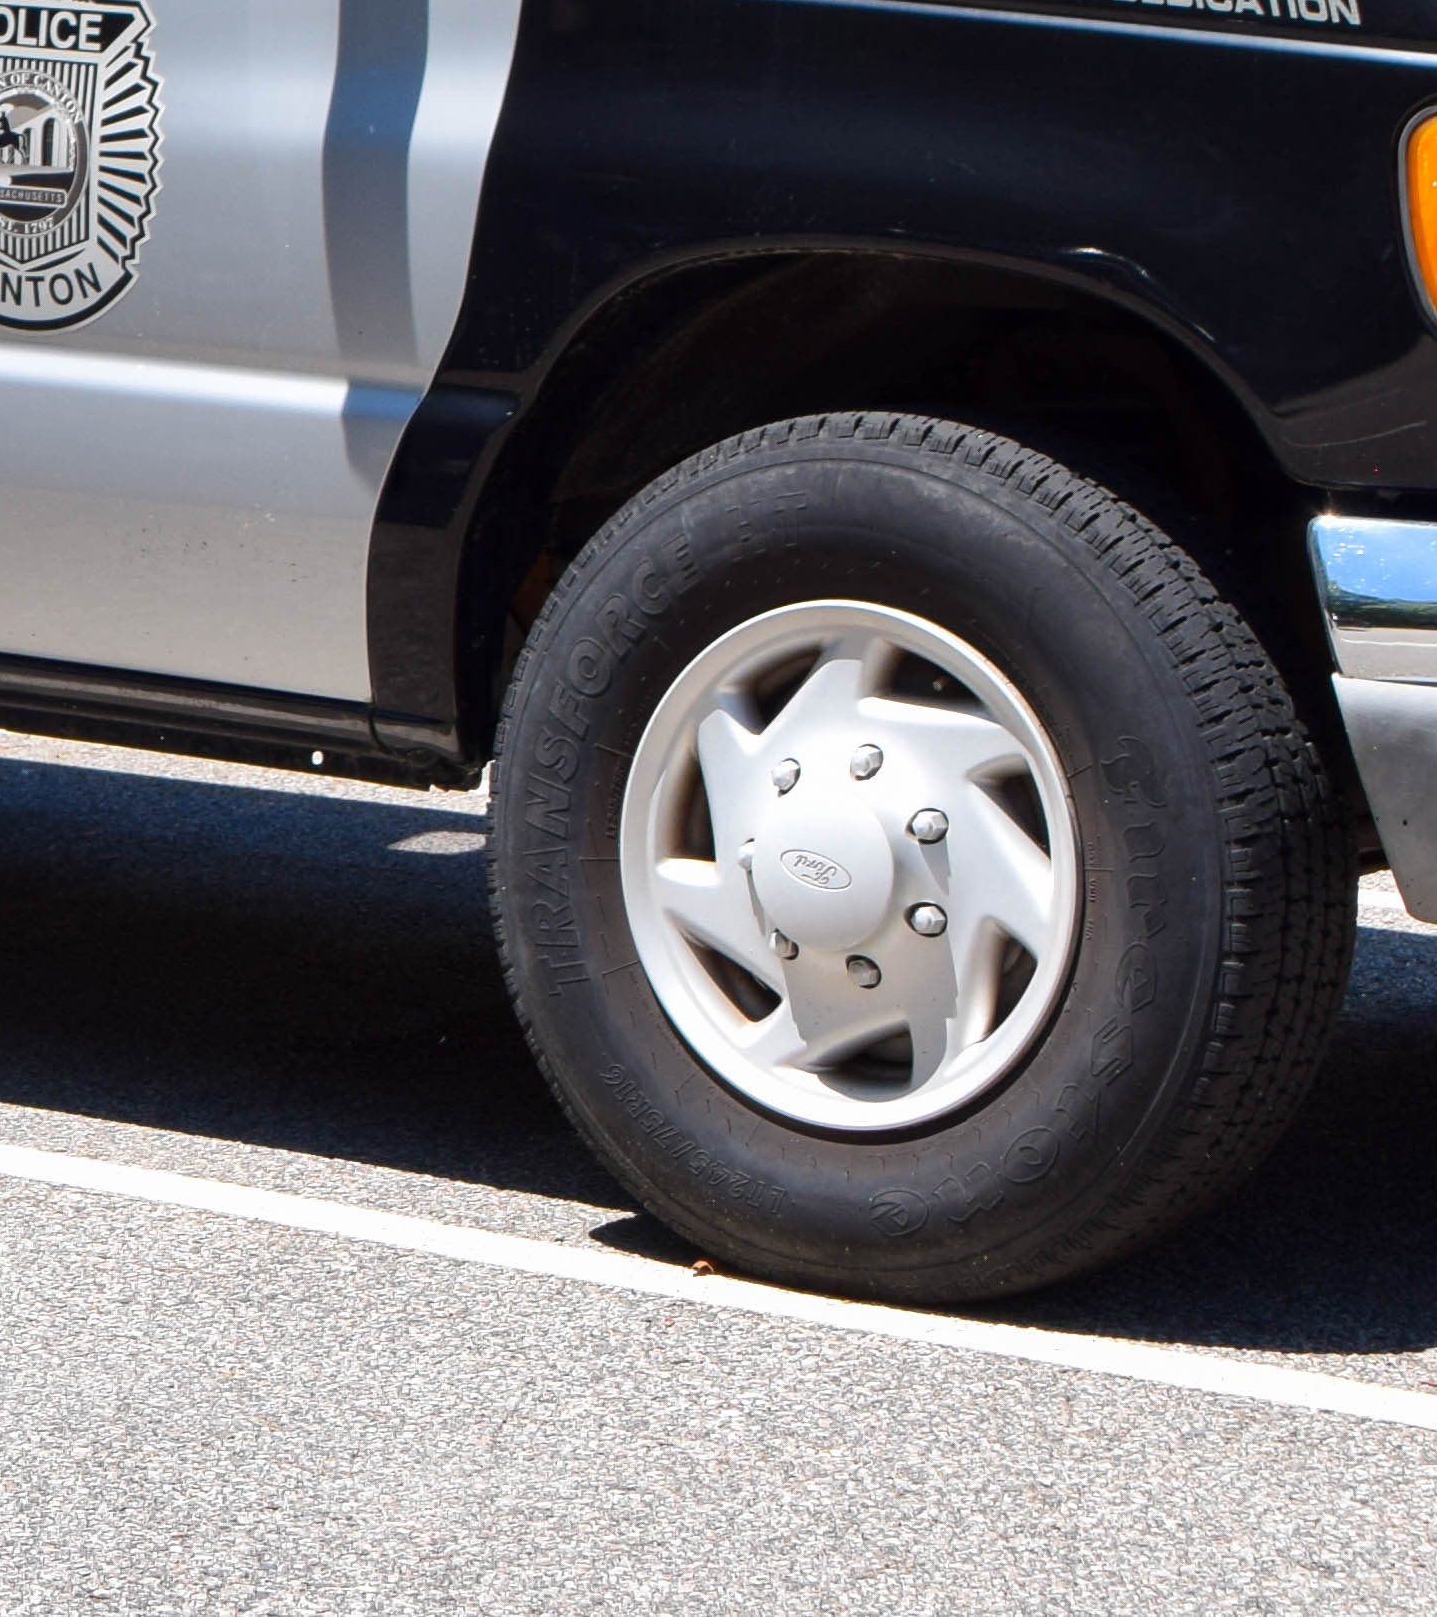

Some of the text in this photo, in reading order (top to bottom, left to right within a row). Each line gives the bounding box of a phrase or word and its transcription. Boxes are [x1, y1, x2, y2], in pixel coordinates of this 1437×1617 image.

[10, 73, 31, 85] OF
[33, 75, 84, 124] CANTON
[24, 217, 54, 234] 1797
[525, 529, 700, 999] TRANSFORCE
[792, 854, 838, 885] Ford
[599, 1063, 789, 1218] LT245/75R16
